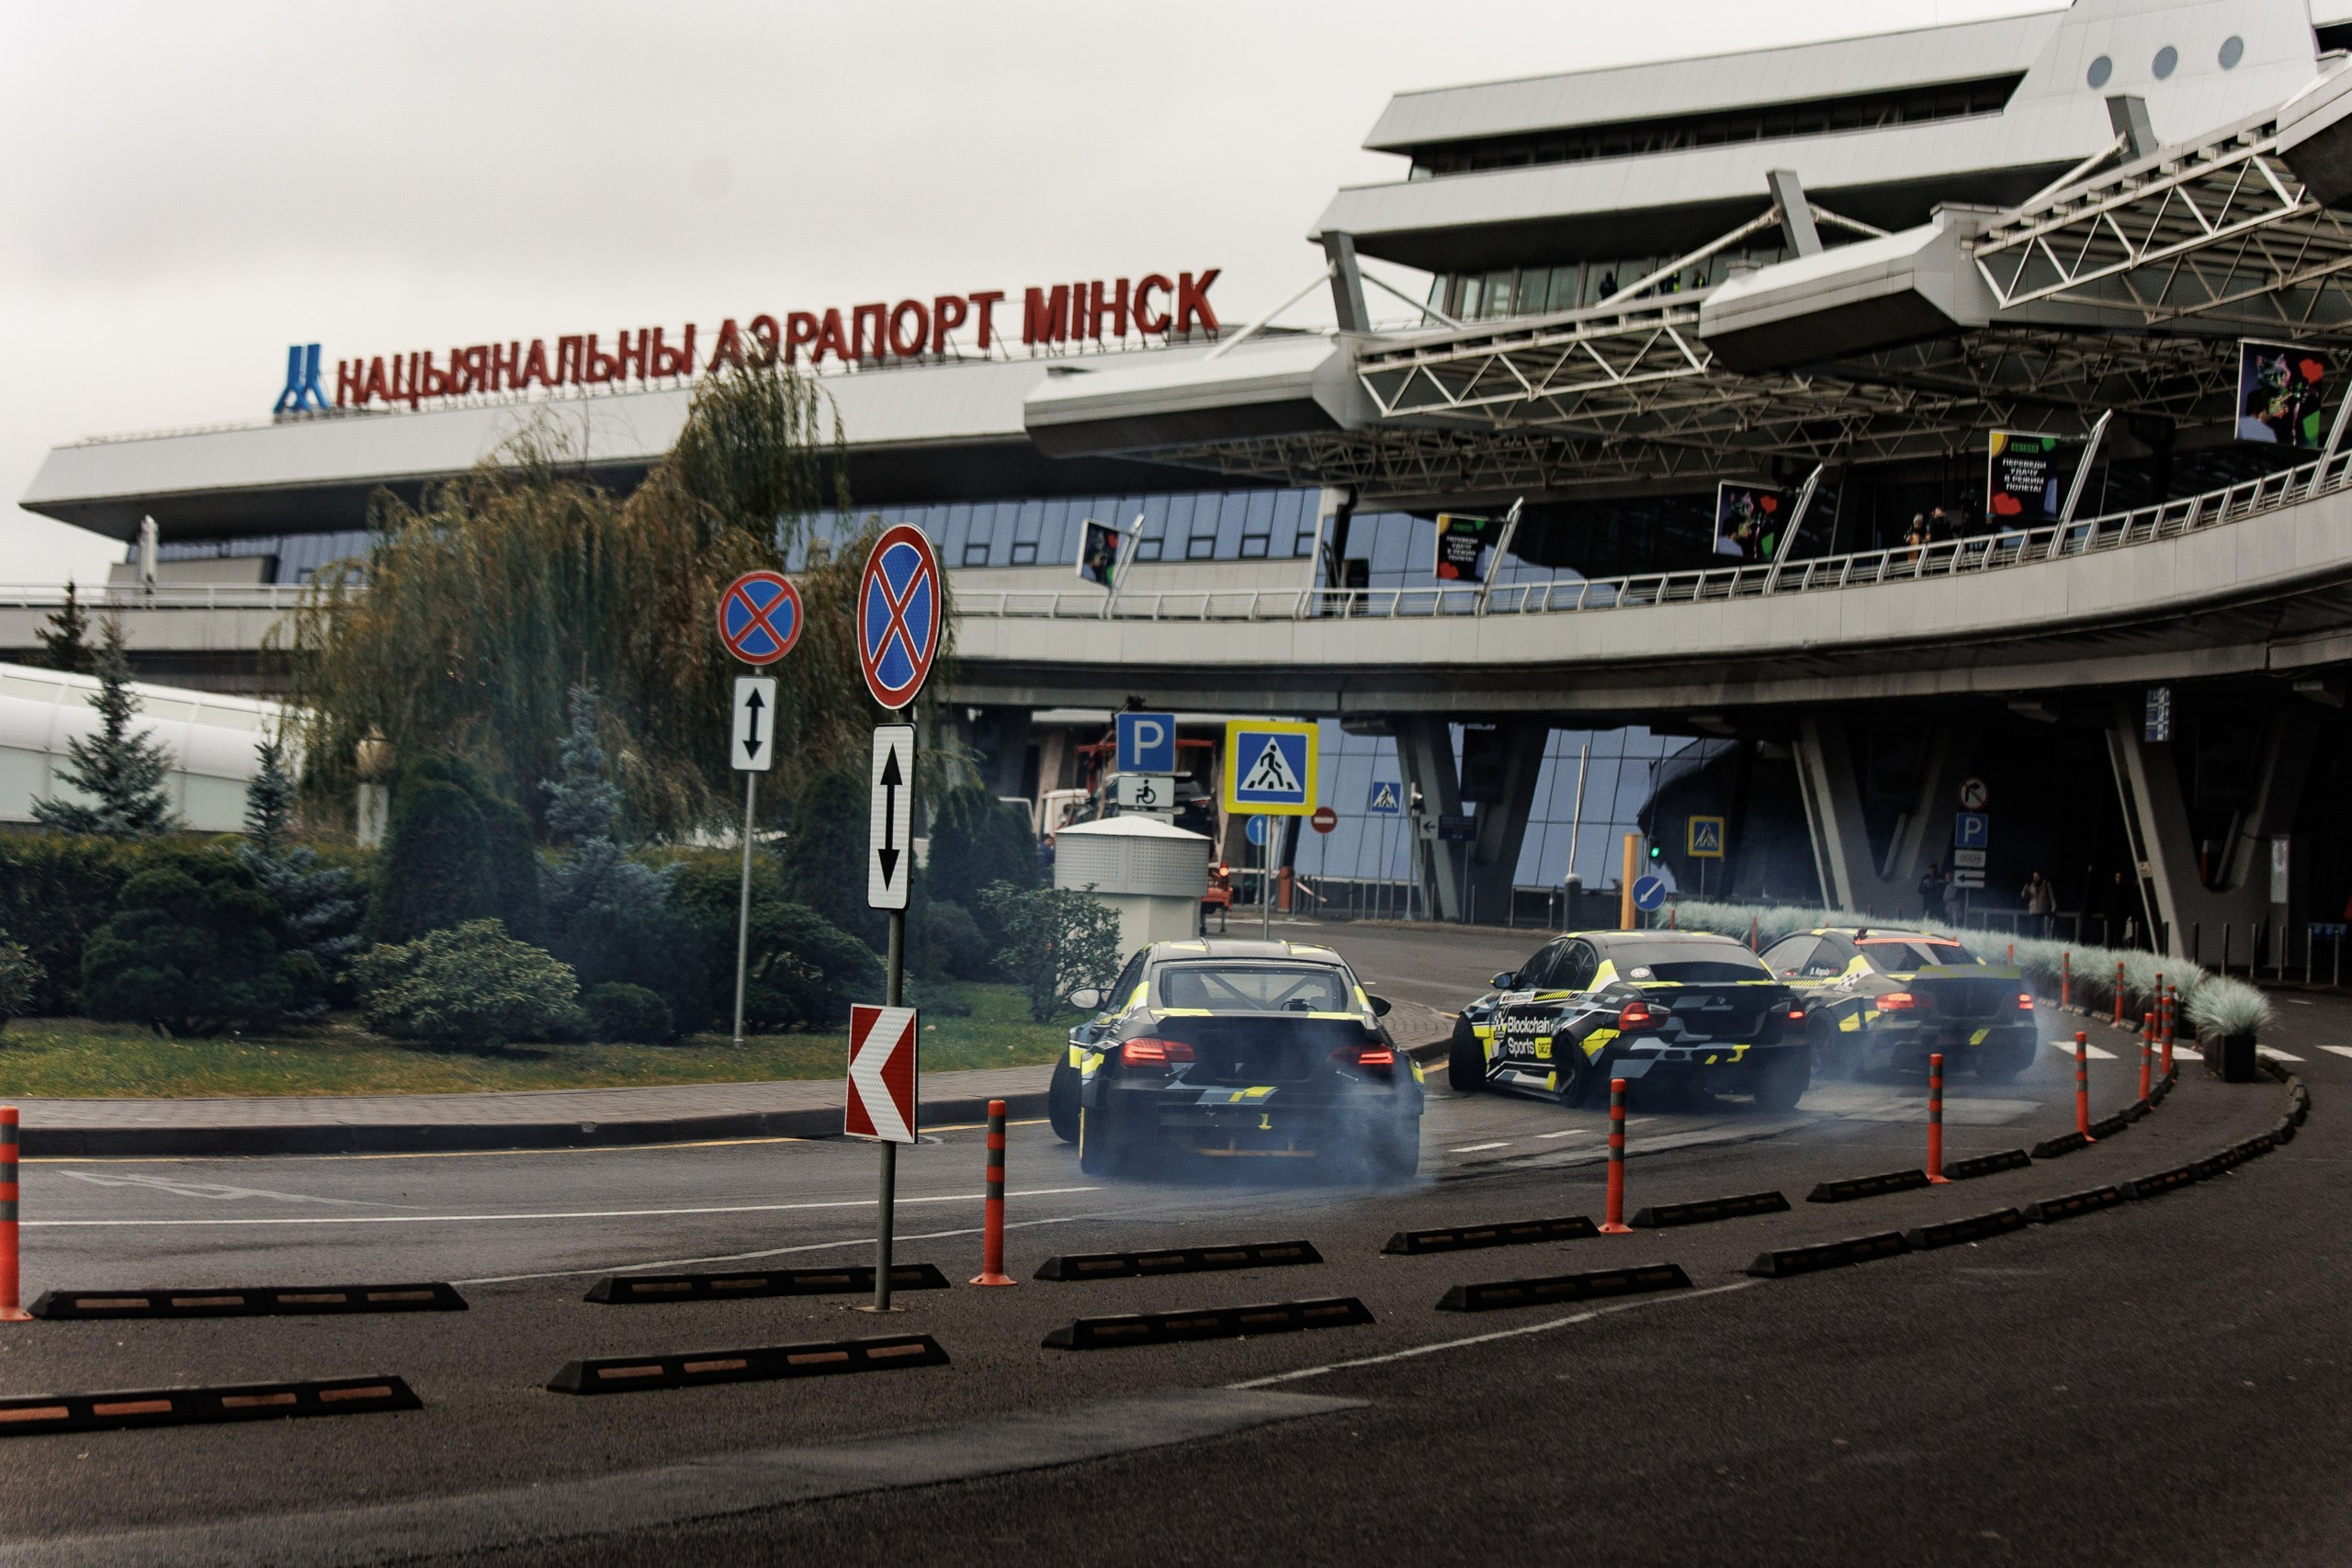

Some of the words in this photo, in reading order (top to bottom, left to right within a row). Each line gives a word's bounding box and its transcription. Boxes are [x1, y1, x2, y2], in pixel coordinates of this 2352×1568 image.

[336, 323, 695, 410] НАЦЫЯНАЛЬНЫ
[707, 291, 1005, 373] АЭРАПОРТ
[1022, 268, 1221, 346] МІНСК
[2003, 457, 2047, 469] ПЕРЕВЕДИ
[1134, 720, 1165, 765] P
[1964, 816, 1982, 843] P
[1507, 1016, 1551, 1034] Blockchain
[1508, 1038, 1535, 1057] Sports
